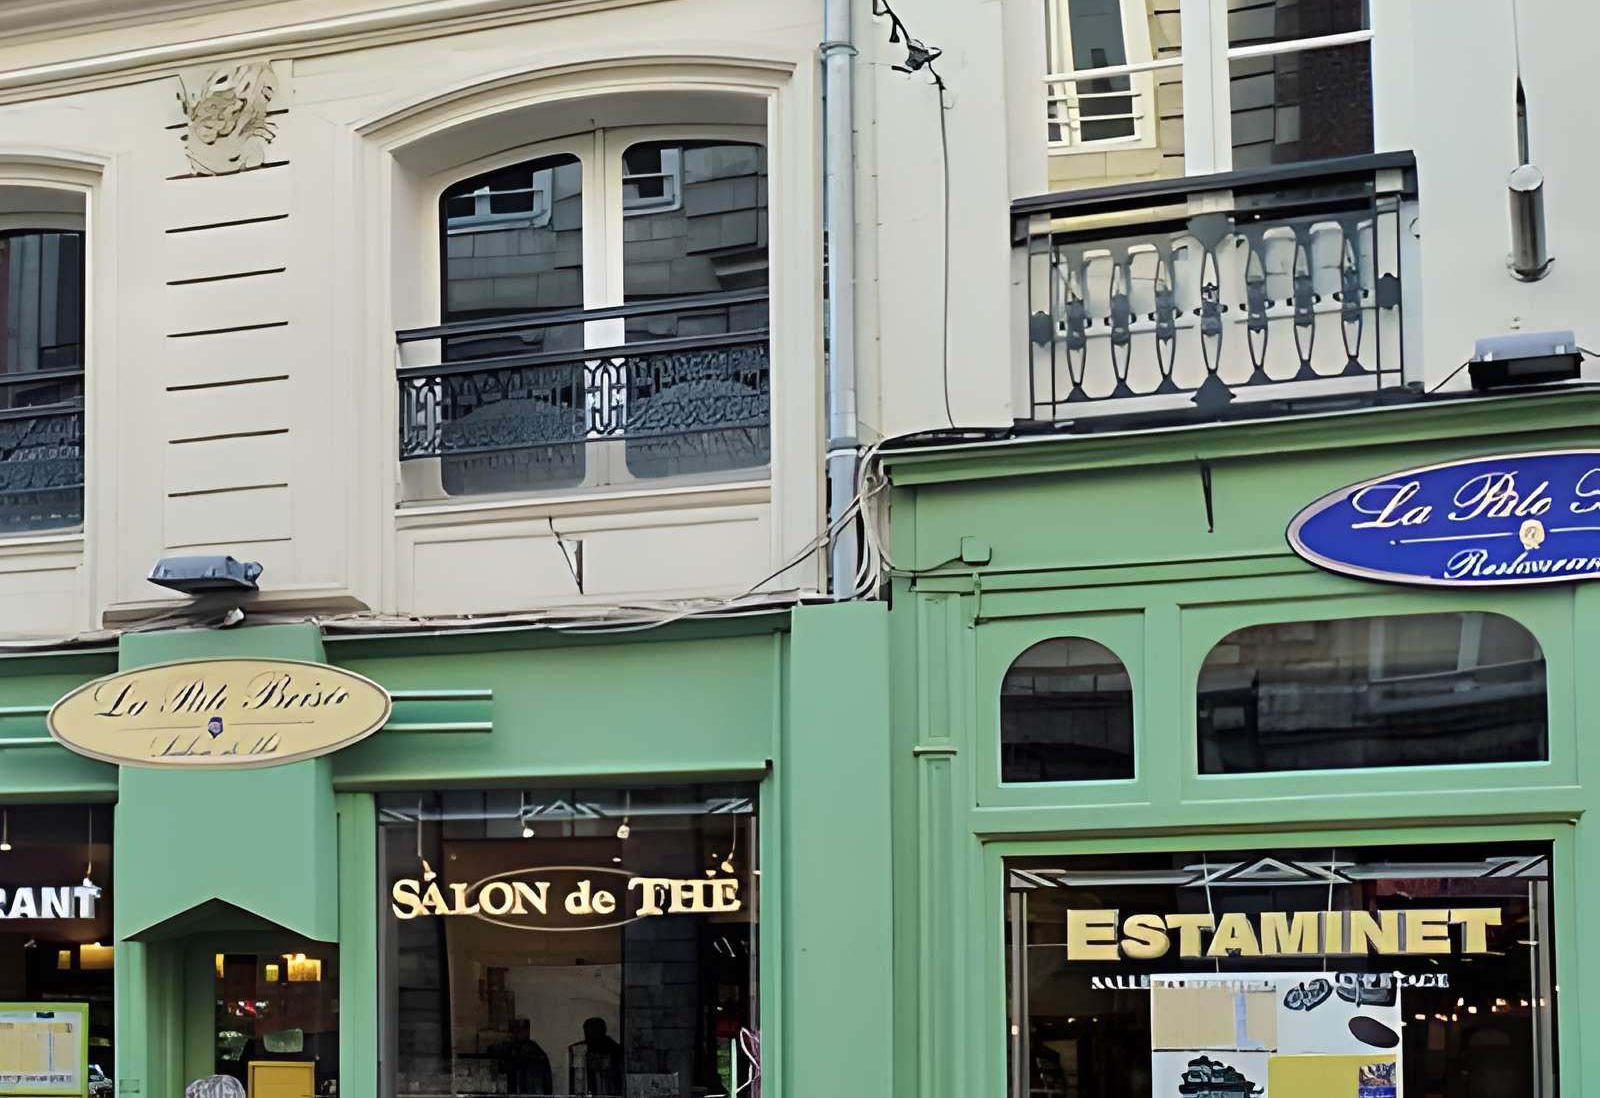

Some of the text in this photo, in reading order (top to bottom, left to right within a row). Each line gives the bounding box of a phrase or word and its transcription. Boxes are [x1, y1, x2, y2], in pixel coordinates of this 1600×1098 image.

[1351, 480, 1434, 529] La
[391, 876, 551, 920] SALON
[563, 879, 617, 915] de
[1066, 907, 1503, 961] ESTAMINET
